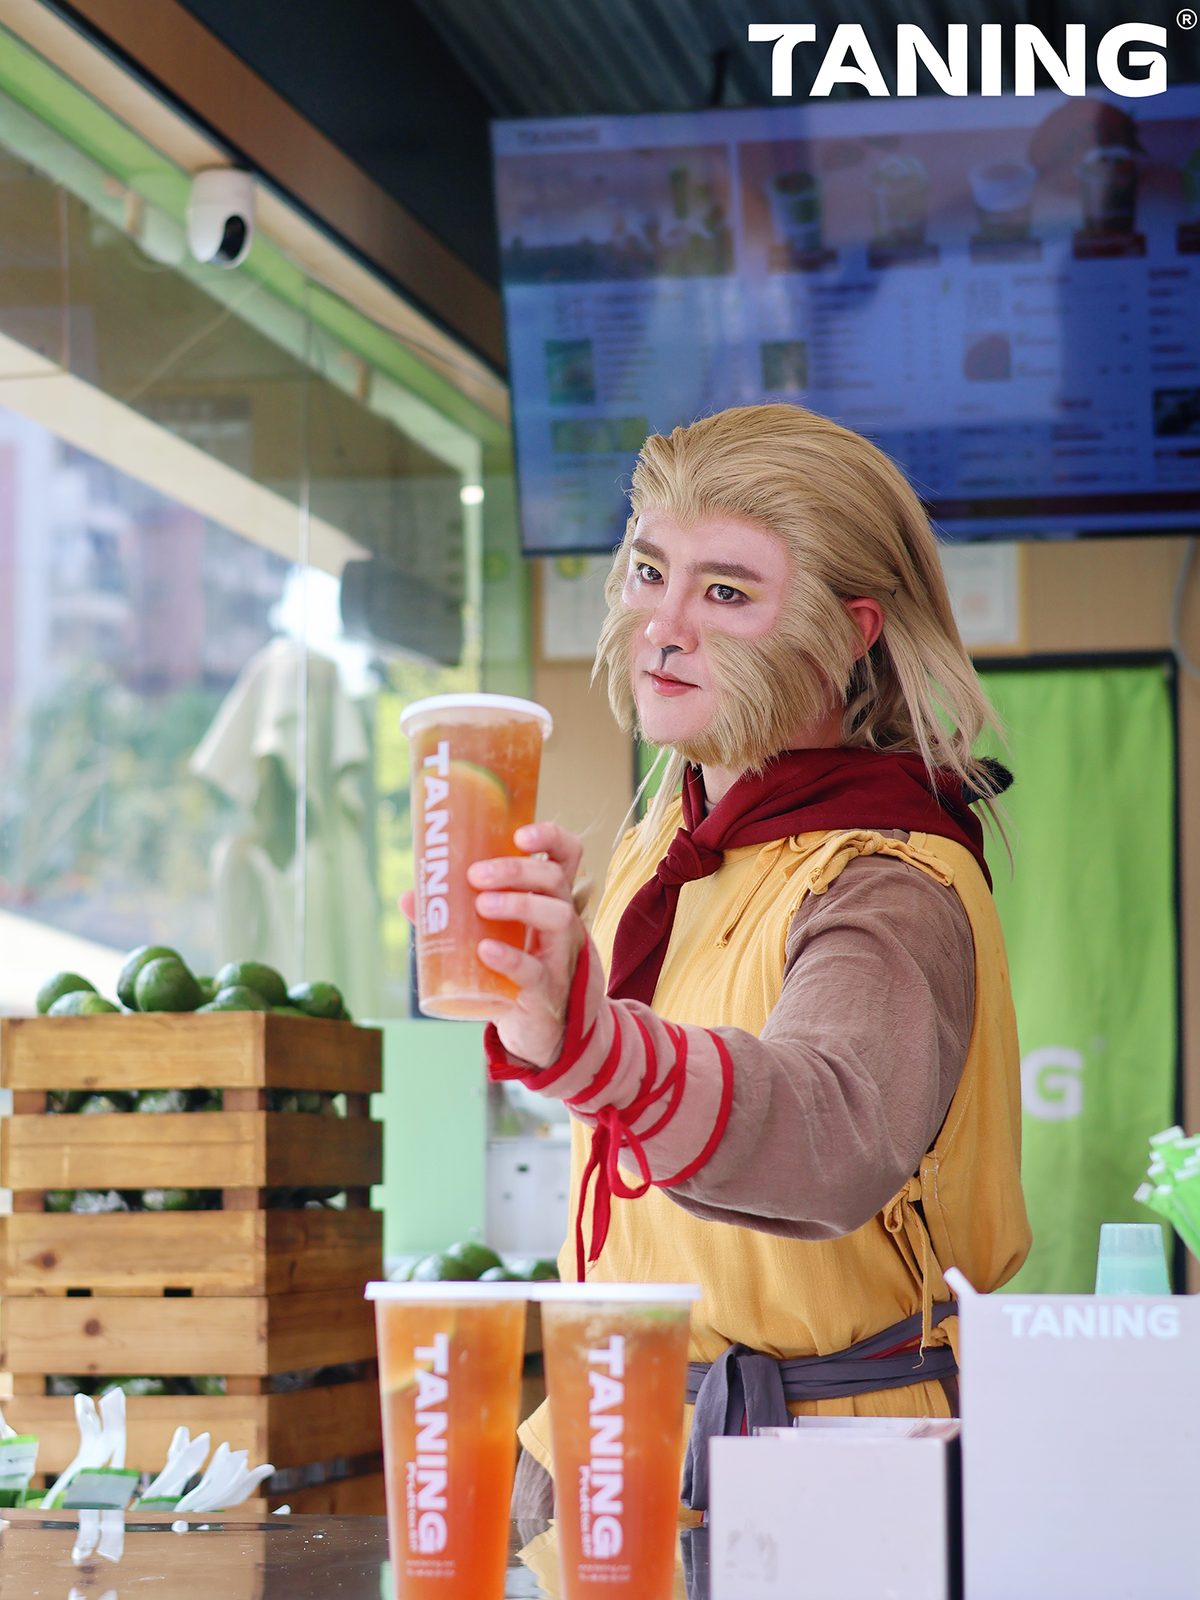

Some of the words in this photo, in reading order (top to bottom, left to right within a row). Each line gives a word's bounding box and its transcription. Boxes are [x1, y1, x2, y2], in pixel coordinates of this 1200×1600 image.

[423, 741, 449, 934] TANING
[1002, 1304, 1180, 1338] TANING
[414, 1332, 449, 1555] TANING
[588, 1335, 625, 1559] TANING
